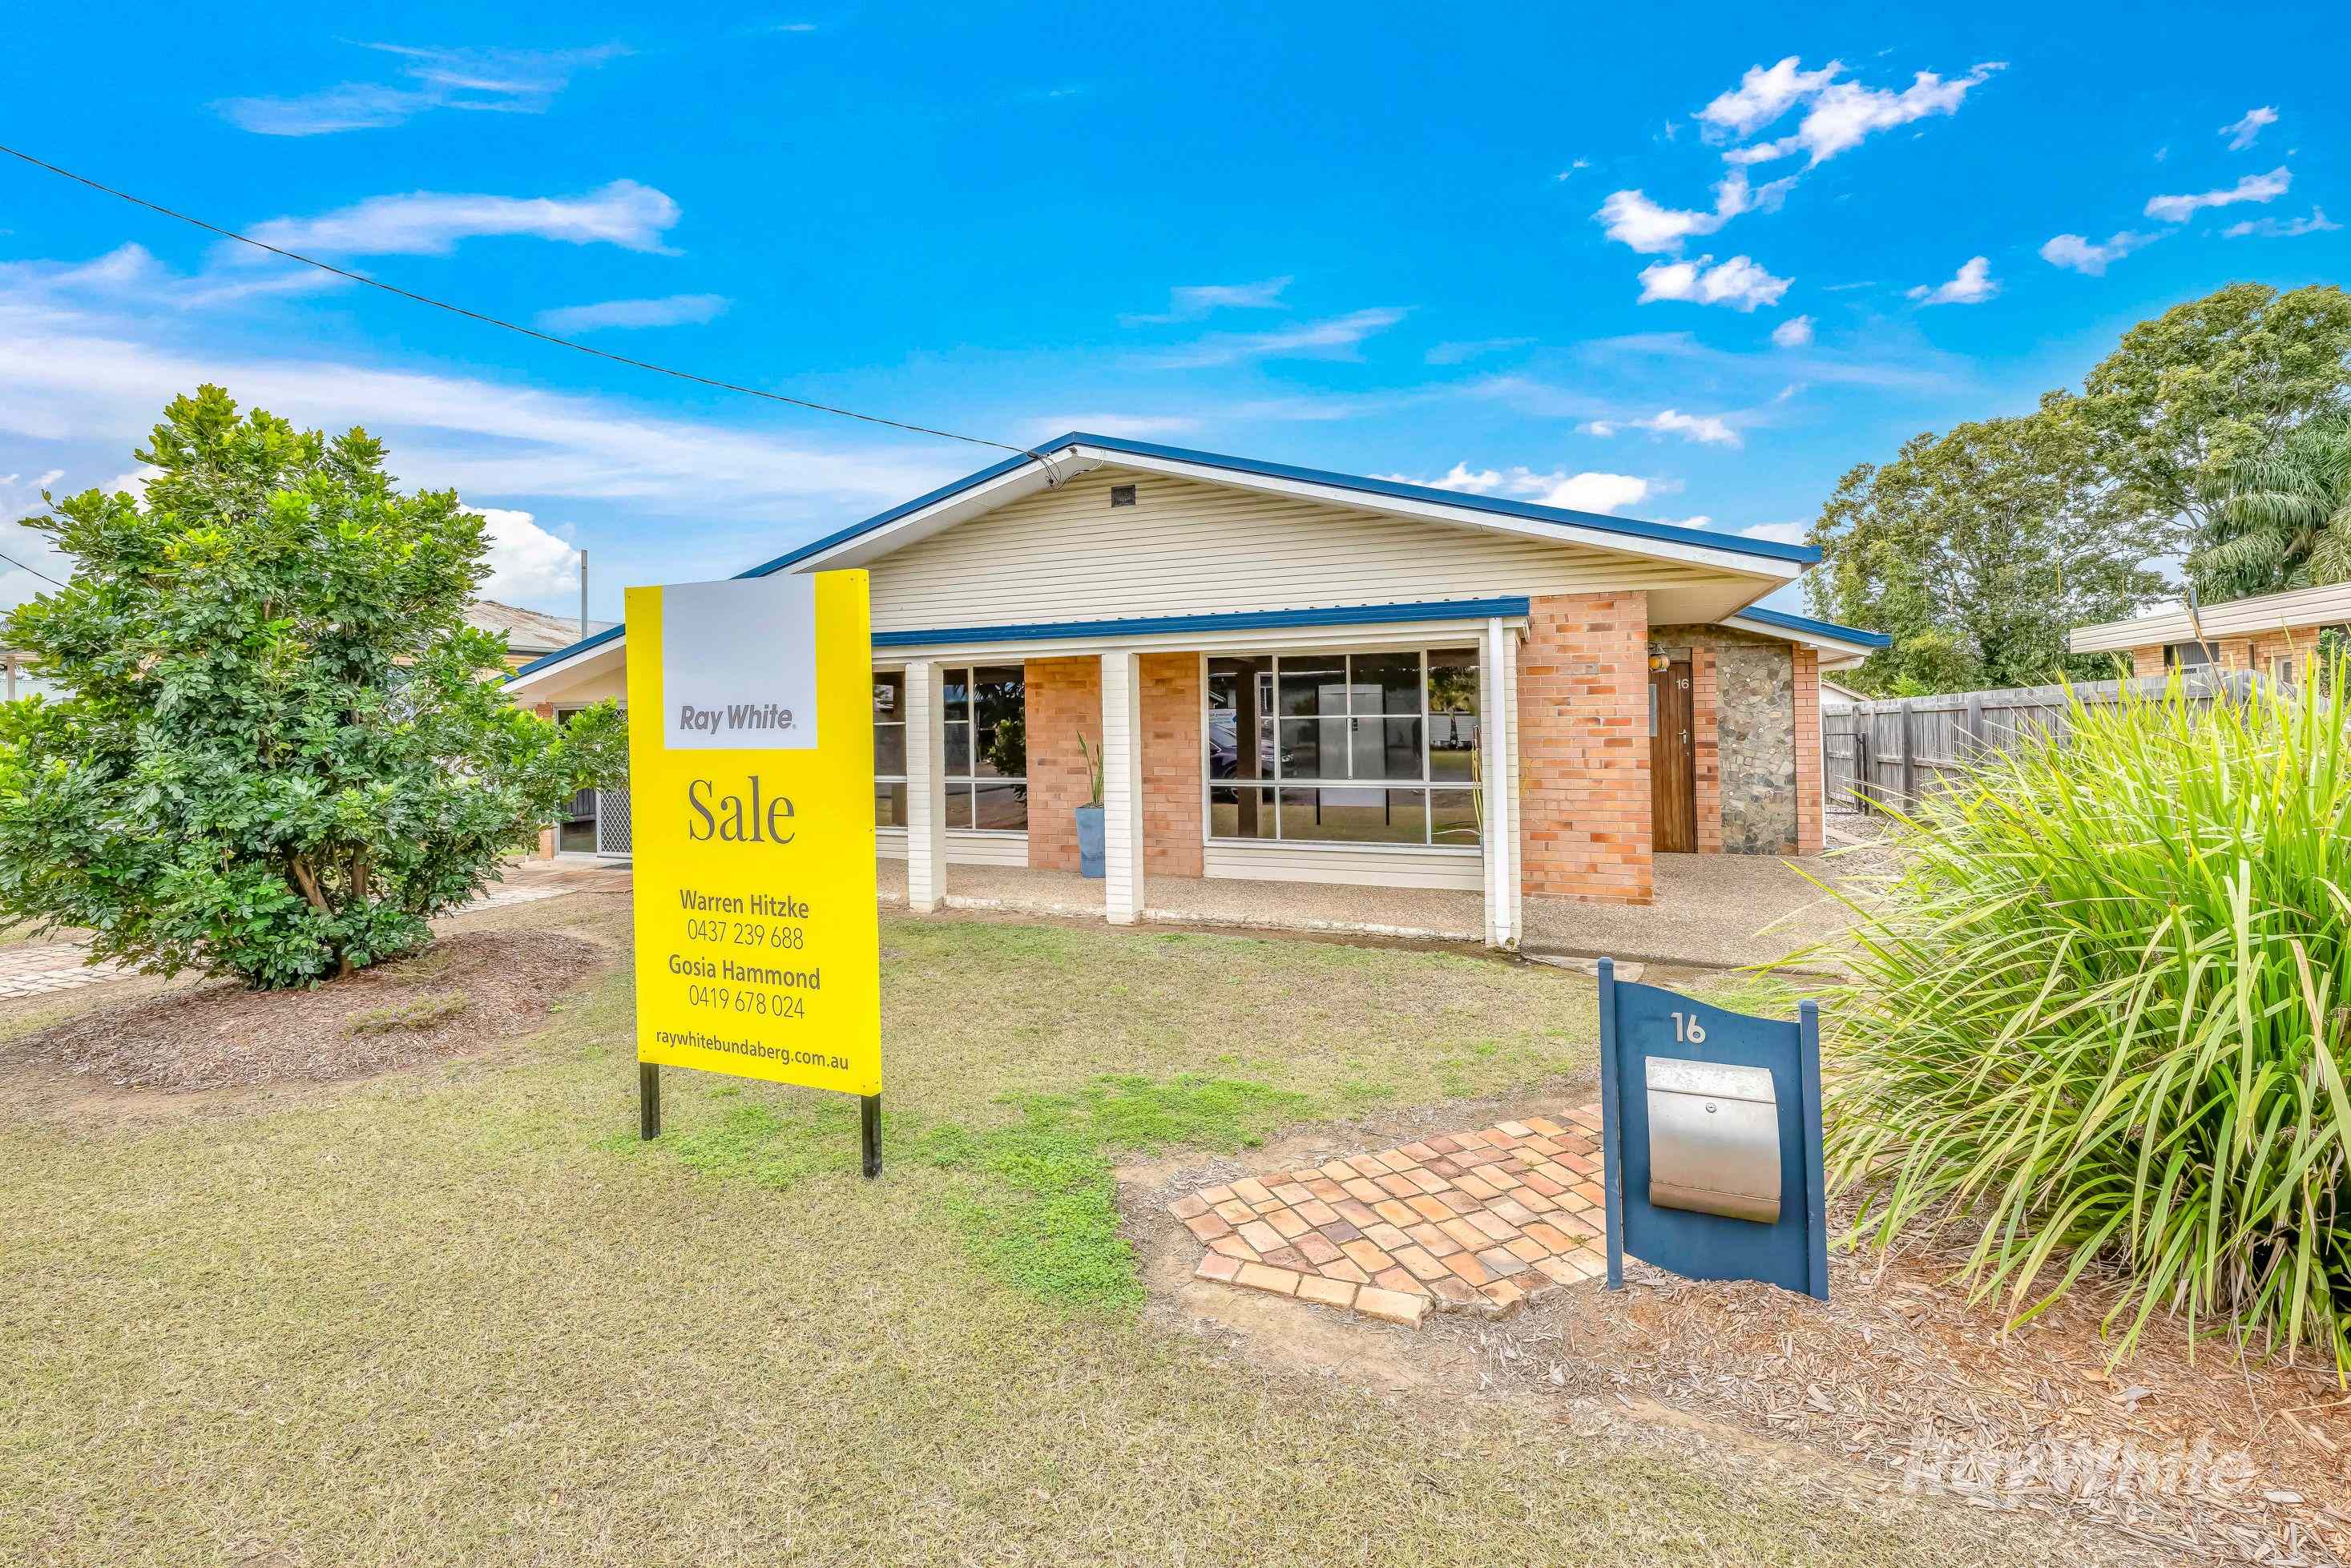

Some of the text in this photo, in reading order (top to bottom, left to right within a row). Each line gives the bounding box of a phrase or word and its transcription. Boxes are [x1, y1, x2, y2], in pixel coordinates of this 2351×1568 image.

[1676, 679, 1689, 690] 16
[679, 705, 723, 735] Ray
[688, 775, 796, 844] Sale
[679, 889, 809, 919] Warren Hitzke
[688, 919, 804, 949] 0437 239 688
[669, 954, 821, 990] Gosia Hammond
[689, 985, 805, 1019] 0419 678 024
[1671, 1012, 1706, 1044] 16
[656, 1030, 849, 1070] raywhitebundaberg.com.au
